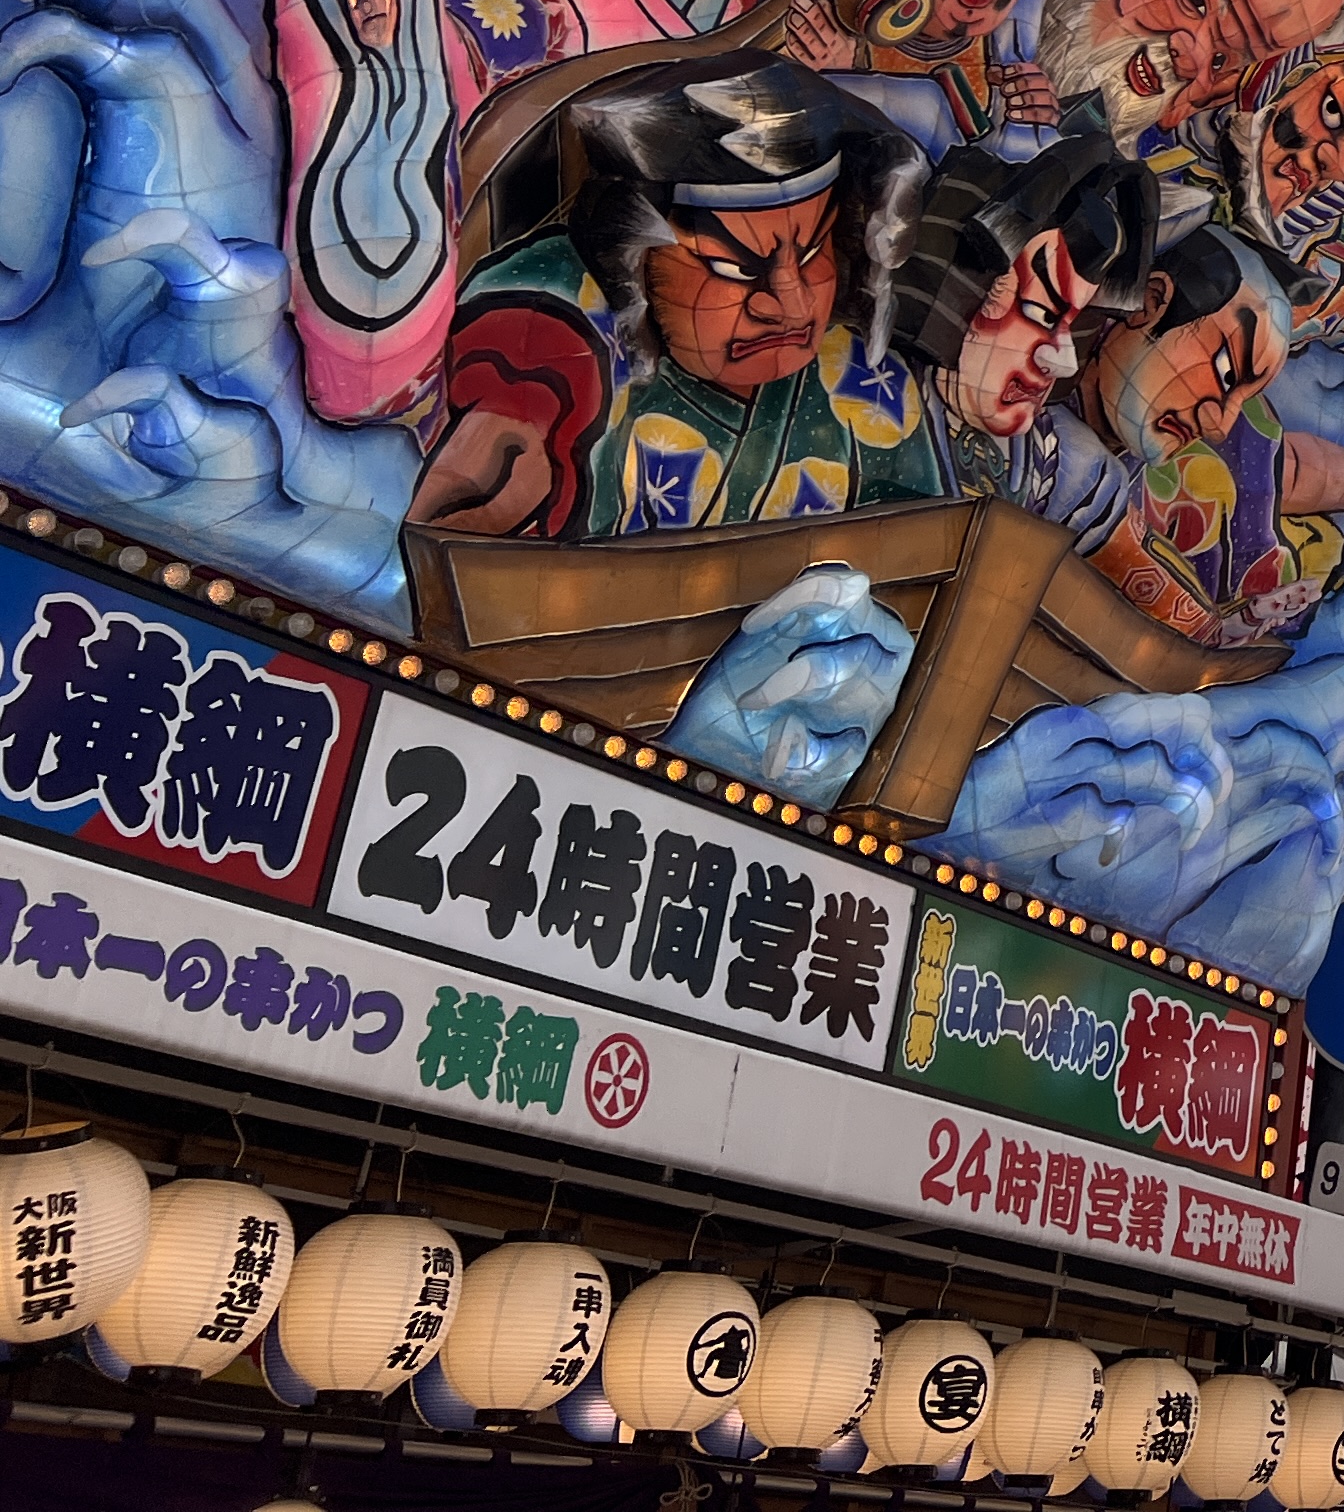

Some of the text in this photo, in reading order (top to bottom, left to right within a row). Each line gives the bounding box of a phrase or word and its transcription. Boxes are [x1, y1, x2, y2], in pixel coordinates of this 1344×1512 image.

[0, 594, 340, 879] 横綱
[358, 744, 891, 1042] 24時間営業
[416, 986, 582, 1115] 横綱
[905, 912, 956, 1071] 新世界
[942, 966, 1118, 1080] 日本一の串かつ
[1116, 990, 1259, 1163] 横綱
[13, 1190, 77, 1225] 大阪
[920, 1117, 1292, 1275] 24時間営業 年中無休
[16, 1220, 77, 1326] 新世界
[197, 1215, 281, 1344] 新鮮逸品
[542, 1272, 603, 1387] 一串入魂
[924, 1361, 983, 1425] 宴
[1149, 1389, 1193, 1467] 横綱
